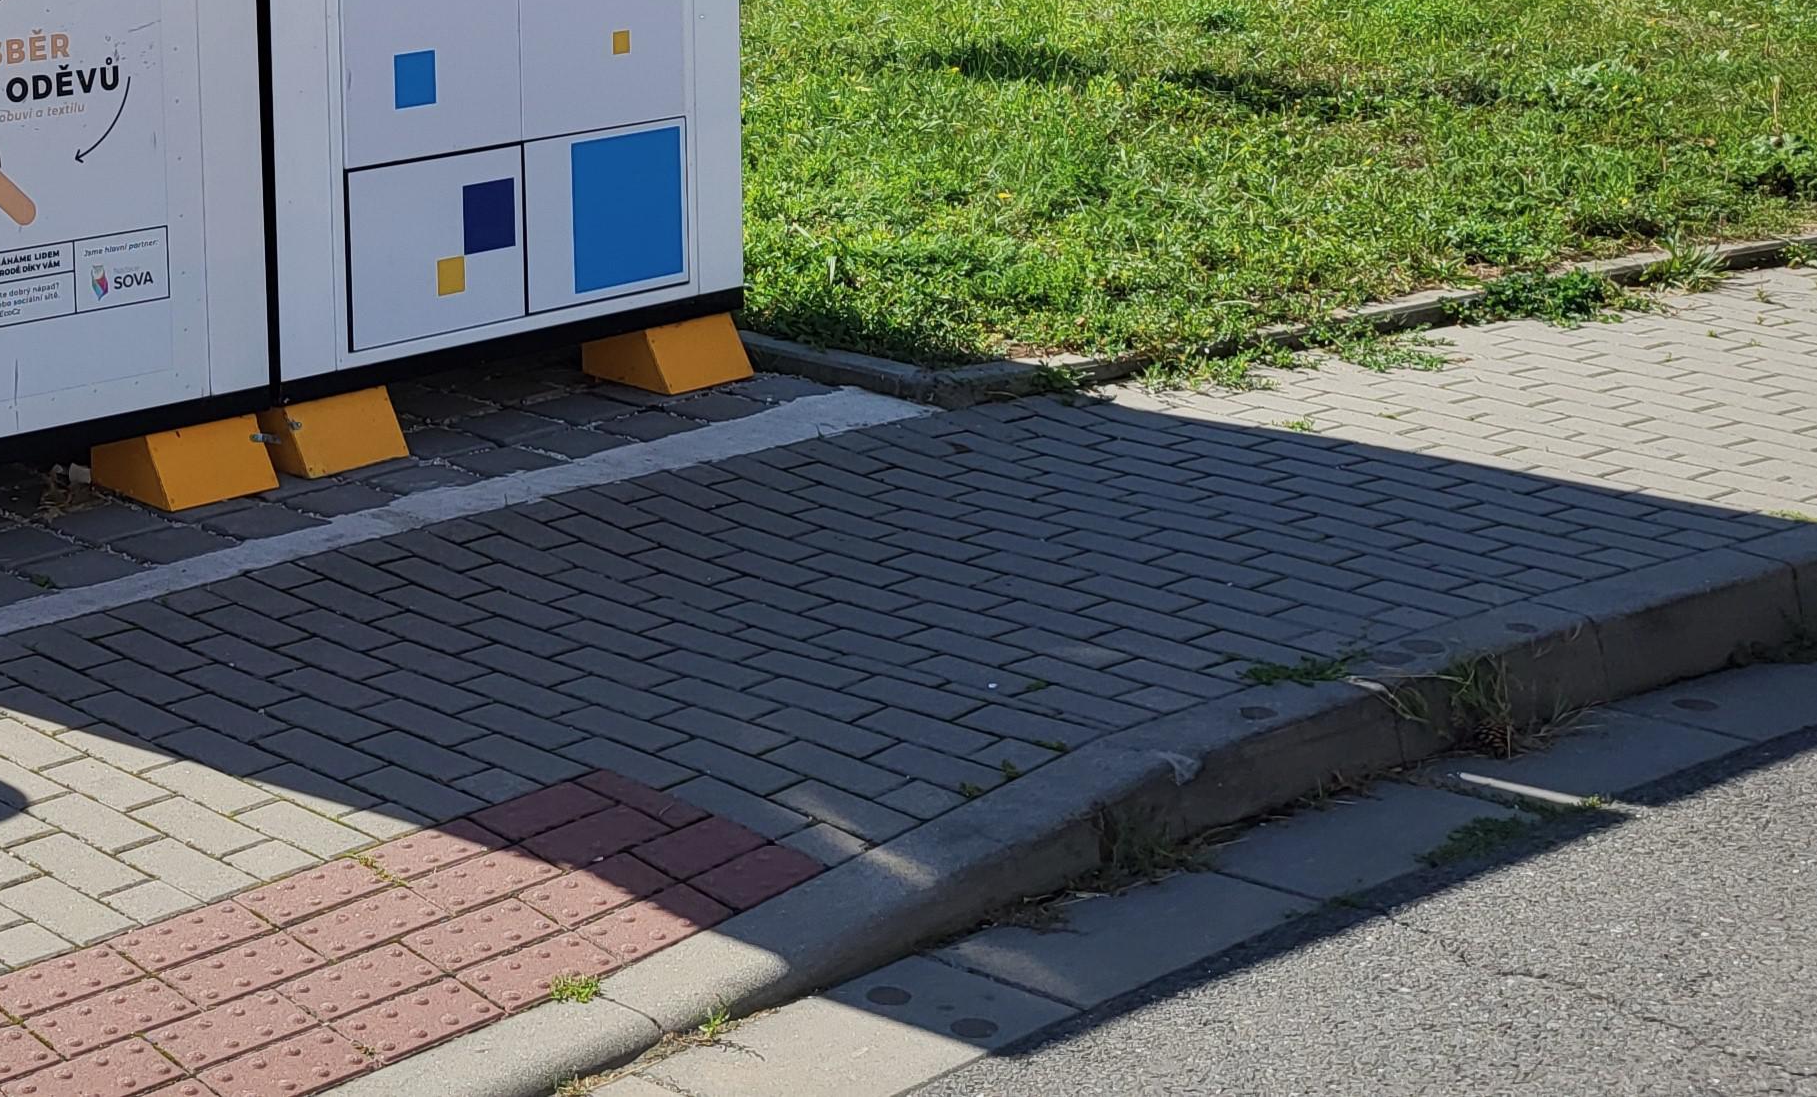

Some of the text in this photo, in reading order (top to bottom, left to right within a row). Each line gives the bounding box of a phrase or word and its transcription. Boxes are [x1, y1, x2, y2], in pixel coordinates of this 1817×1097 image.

[5, 57, 120, 103] ODĚVŮ
[35, 107, 45, 119] a
[46, 101, 86, 117] textilu
[34, 249, 60, 261] LIDEM
[22, 263, 41, 273] DÍKY
[43, 260, 60, 268] VÁM
[114, 270, 154, 289] SOVA
[9, 287, 31, 298] dobrý
